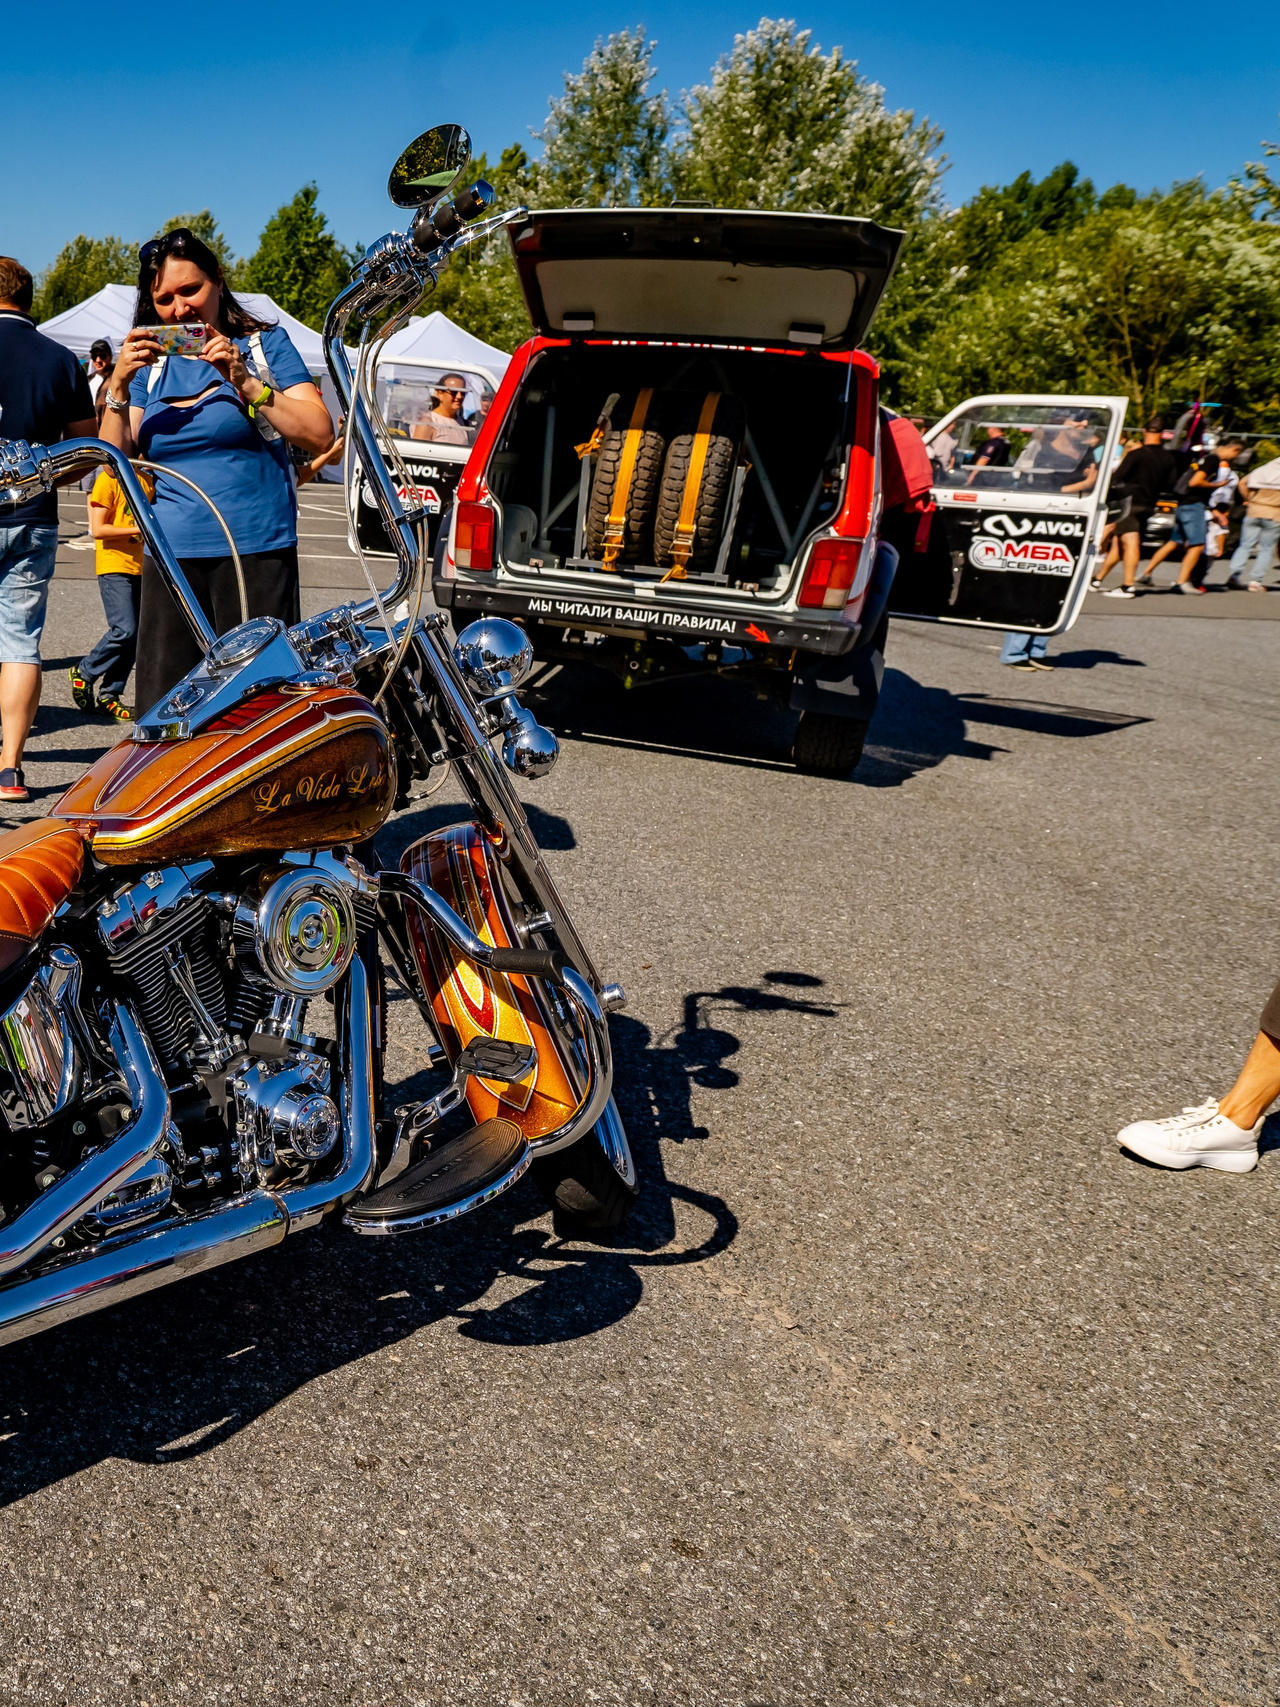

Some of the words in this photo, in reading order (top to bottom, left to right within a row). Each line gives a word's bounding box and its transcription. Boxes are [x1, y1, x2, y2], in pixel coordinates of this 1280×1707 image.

[1031, 520, 1085, 537] AVOL
[1004, 543, 1070, 562] МБА
[1007, 560, 1070, 574] СЕРВИС
[527, 598, 552, 613] МЫ
[555, 601, 612, 619] ЧИТАЛИ
[614, 607, 659, 624] ВАШИ
[662, 612, 737, 634] ПРАВИЛА!
[251, 779, 291, 813] La
[295, 769, 341, 801] Vida
